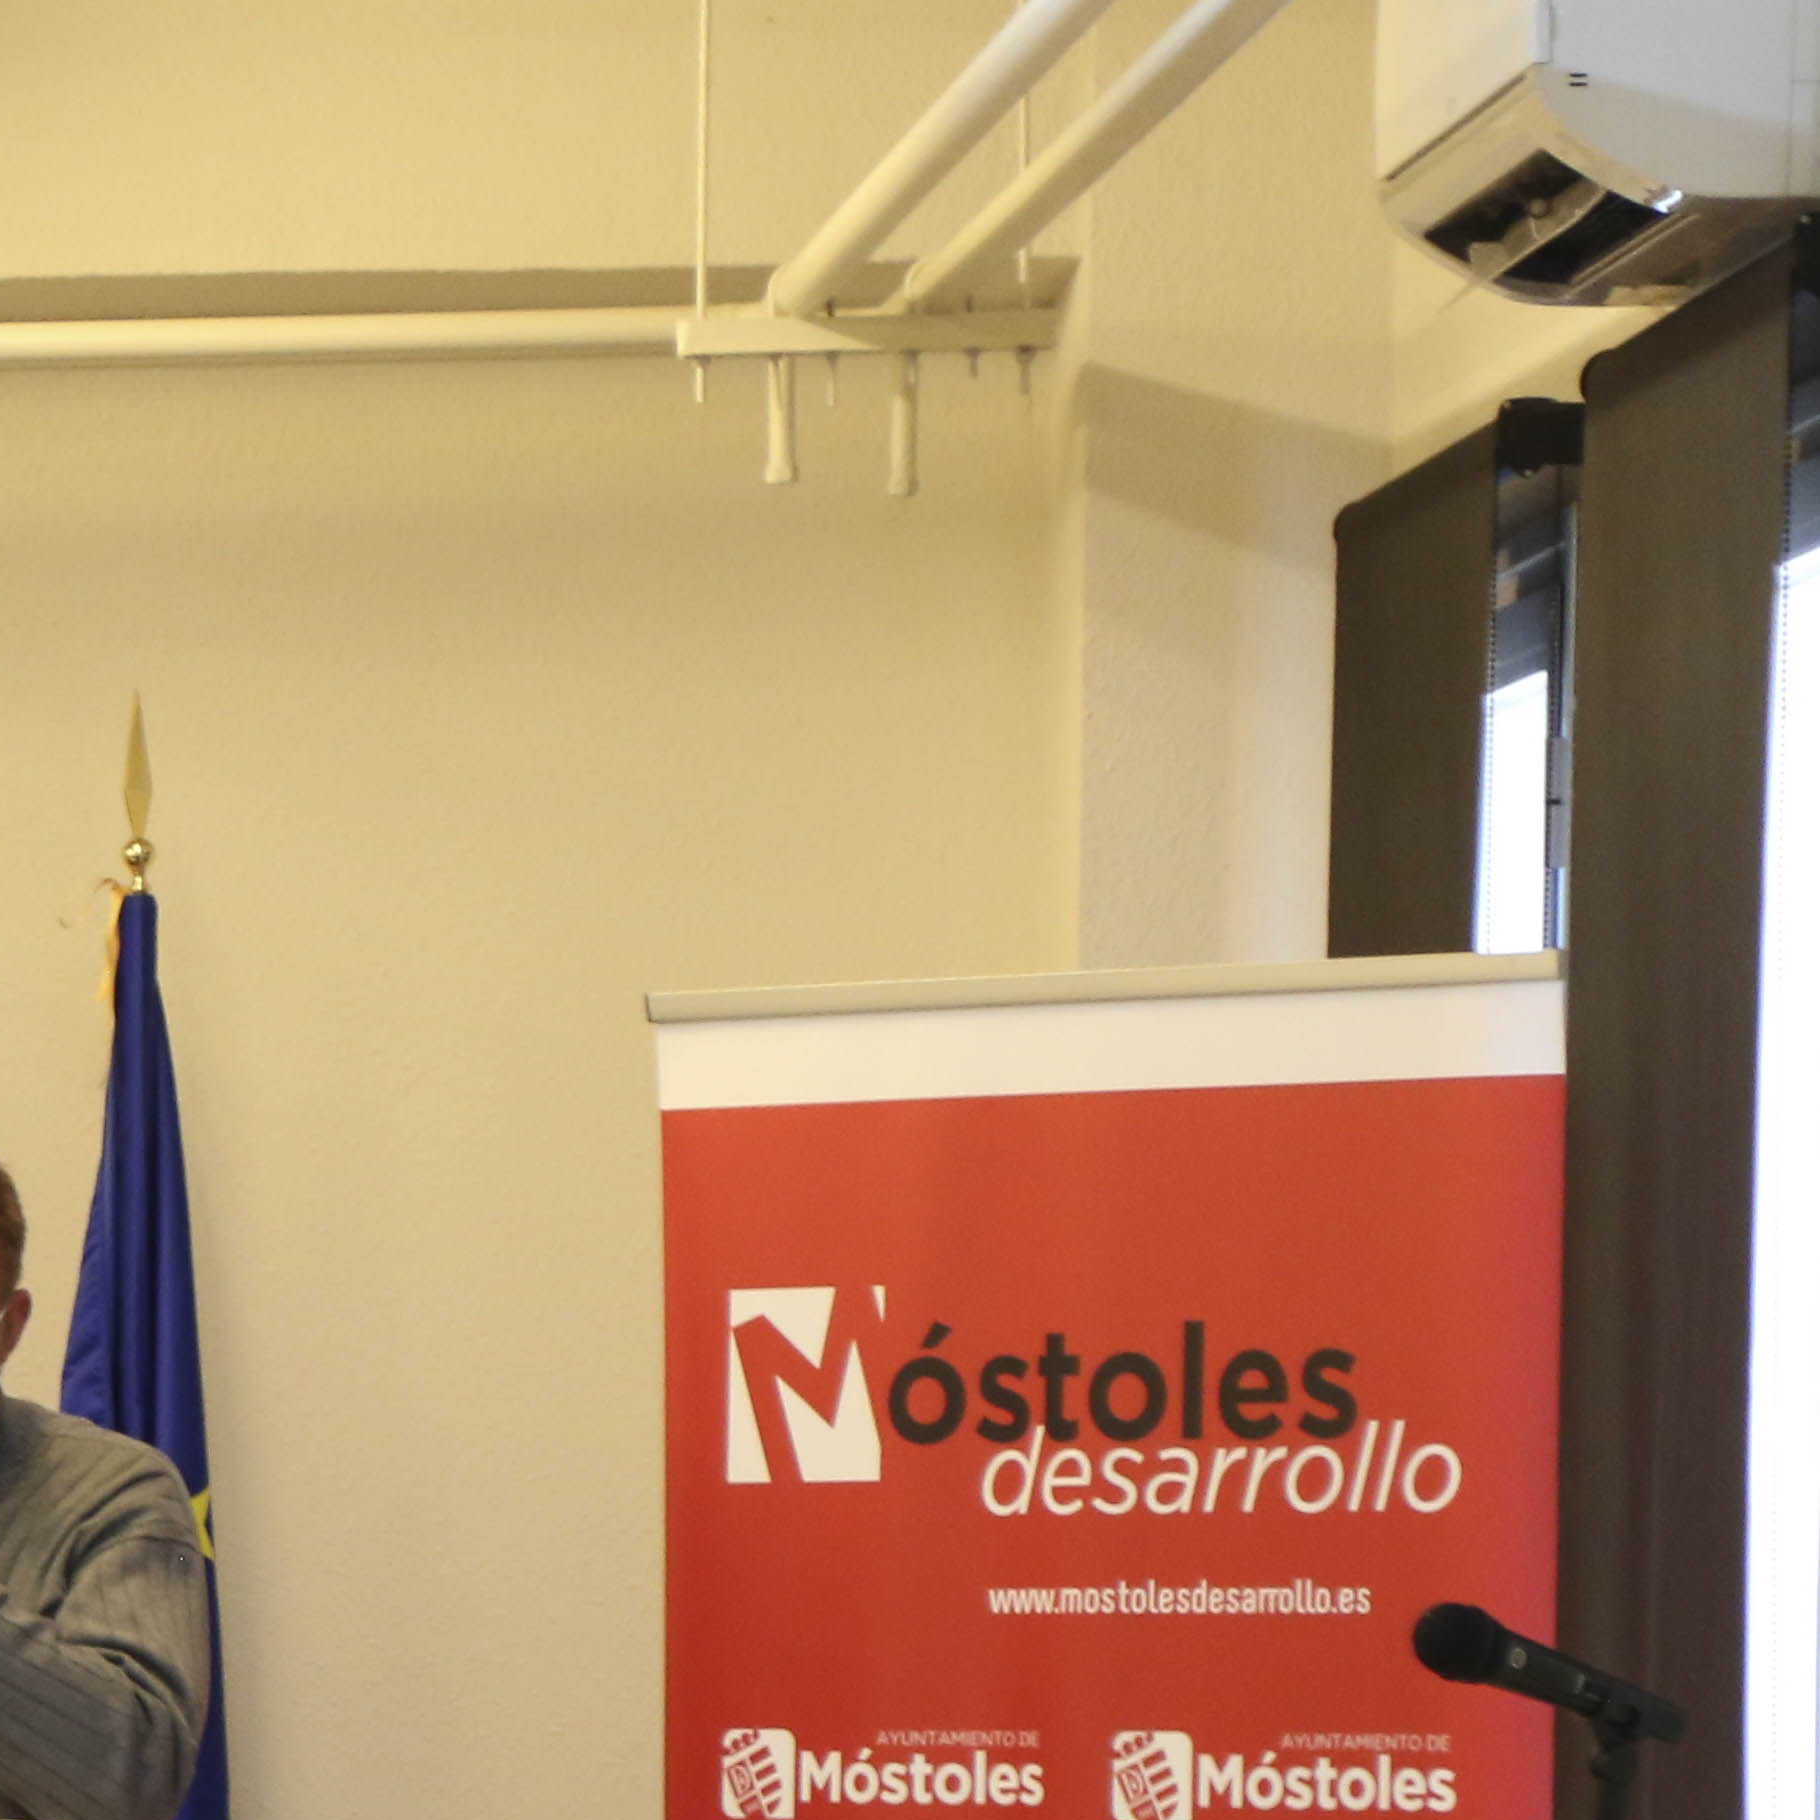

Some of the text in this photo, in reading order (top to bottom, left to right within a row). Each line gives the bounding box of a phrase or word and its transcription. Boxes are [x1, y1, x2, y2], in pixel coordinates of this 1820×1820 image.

[980, 1420, 1462, 1517] desarrollo
[989, 1580, 1371, 1616] www.mostolesdesarrollo.es
[877, 1731, 1039, 1748] AYUNTAMIENTO DE
[1281, 1732, 1450, 1752] AYUNTAMIENTO DE
[799, 1748, 1045, 1805] Móstoles
[1198, 1751, 1457, 1812] Móstoles
